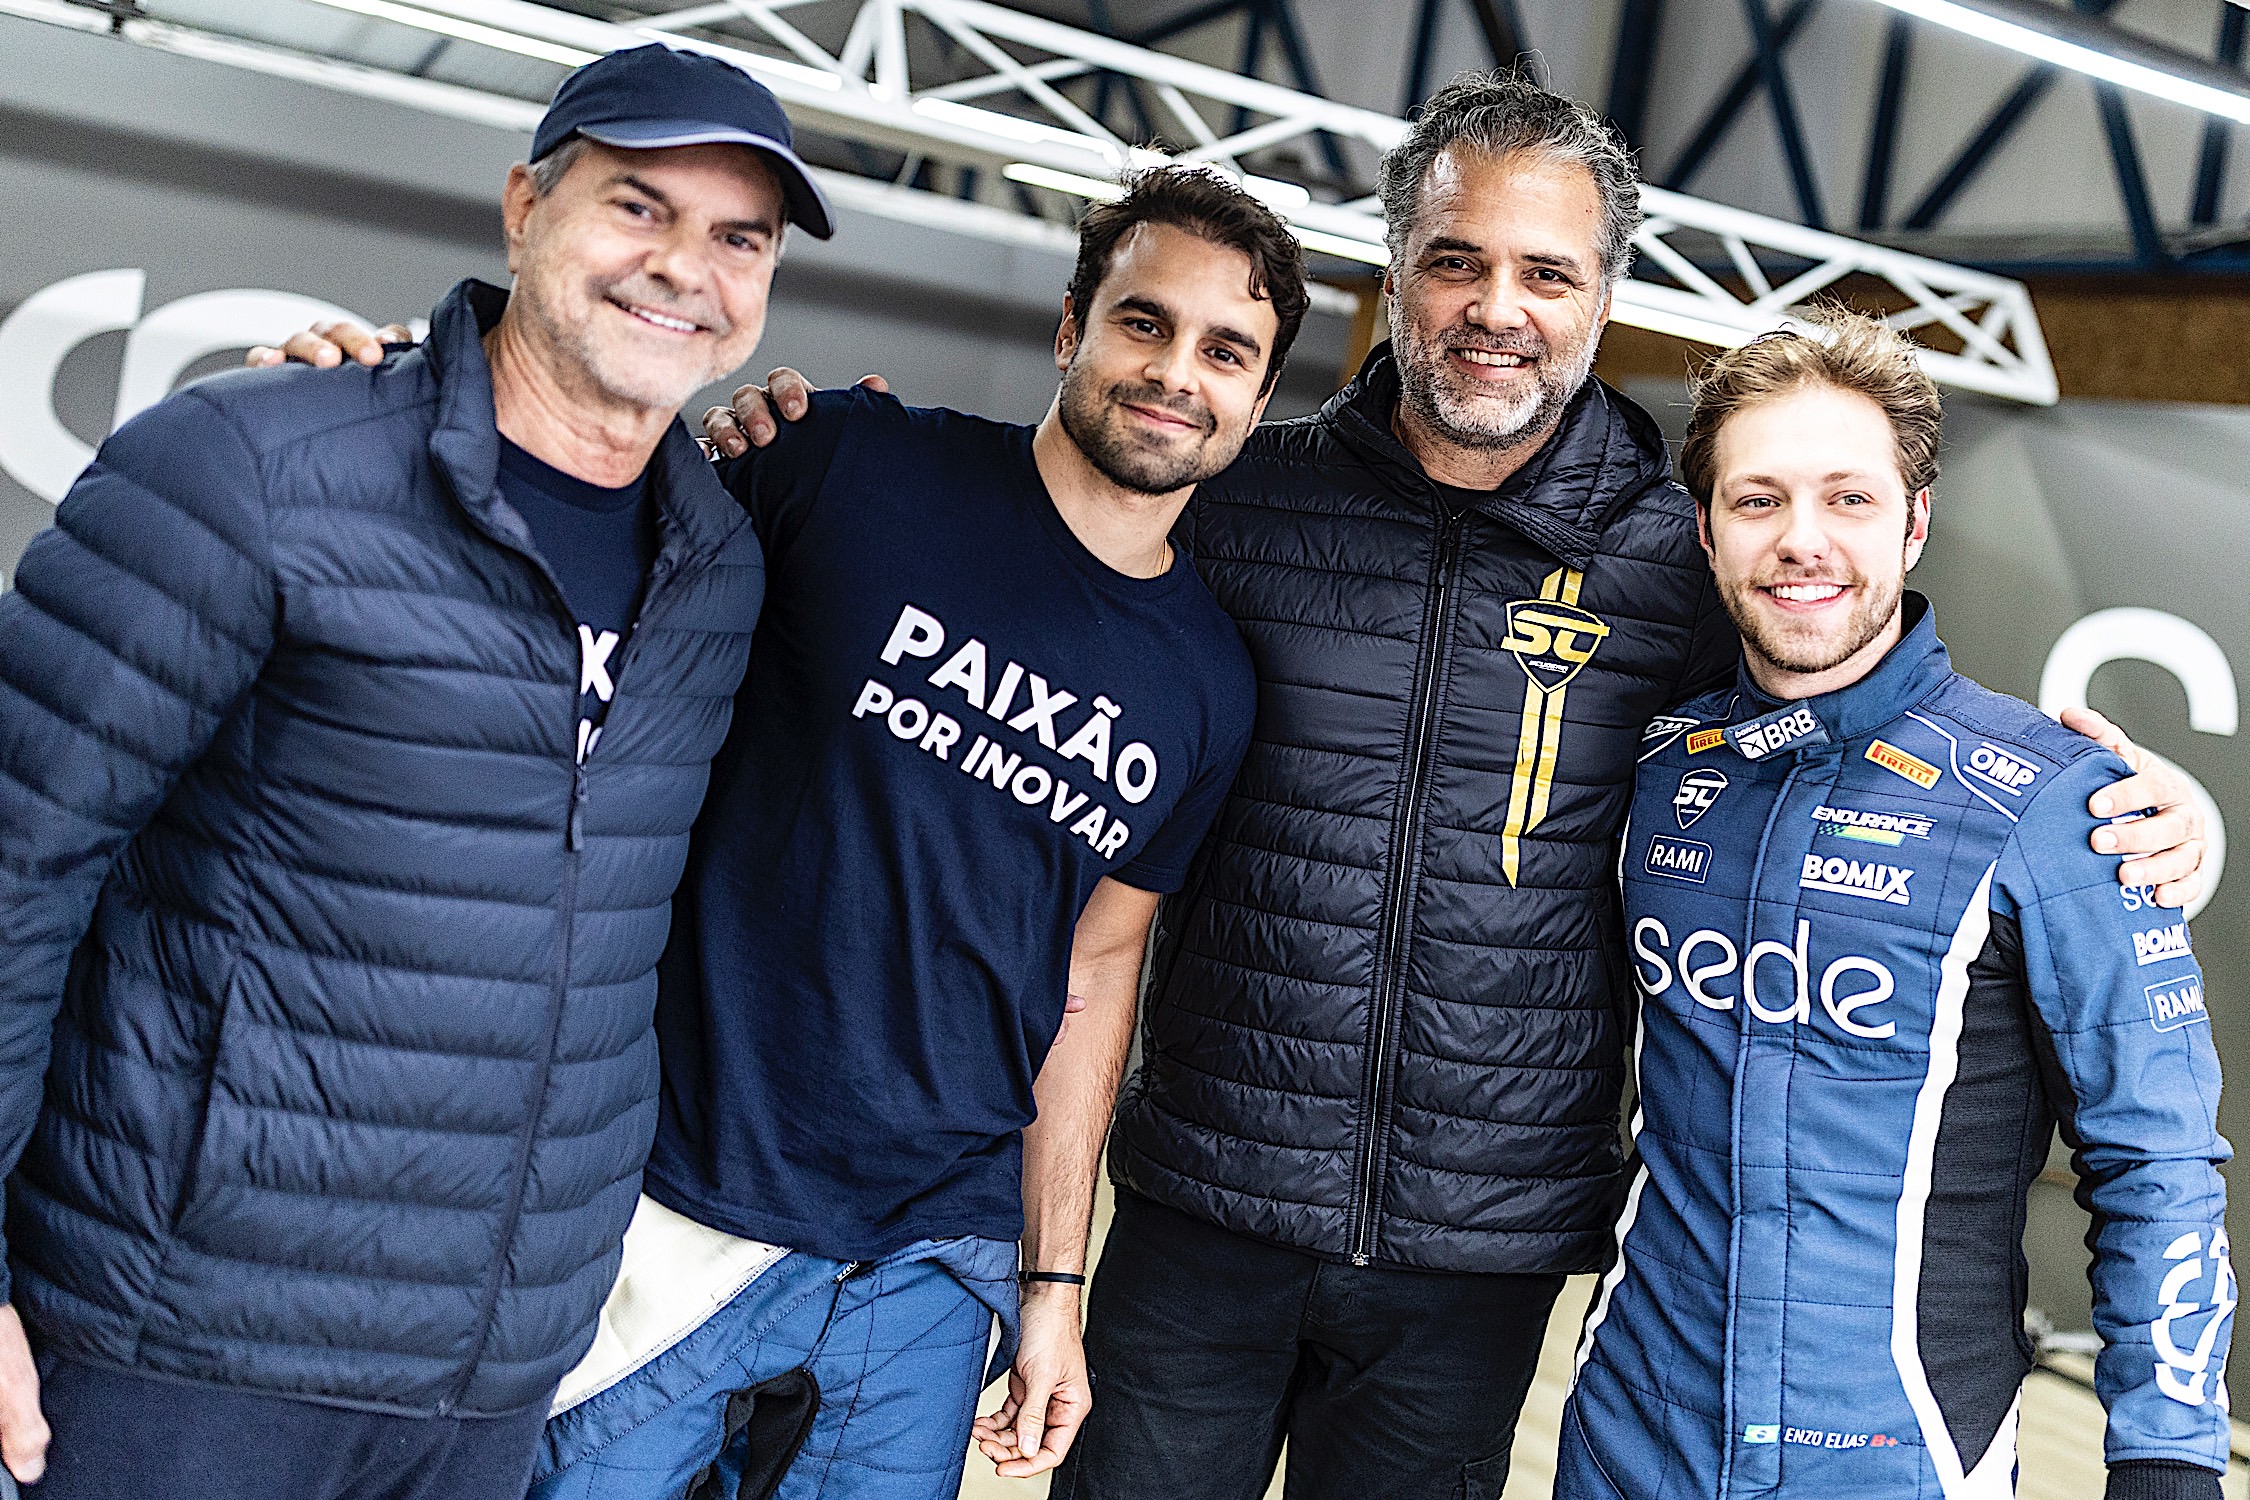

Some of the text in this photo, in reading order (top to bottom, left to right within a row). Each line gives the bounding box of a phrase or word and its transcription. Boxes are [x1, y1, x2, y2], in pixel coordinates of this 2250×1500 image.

[880, 604, 1157, 803] PAIXÃO
[1763, 708, 1816, 750] BRB
[852, 679, 1130, 860] POR INOVAR
[1872, 744, 1935, 784] PIRELLI
[1969, 747, 2036, 788] OMP
[1811, 805, 1933, 836] ENDURANCE
[1650, 844, 1704, 873] RAMI
[1801, 853, 1915, 902] BOMIX
[1634, 917, 1896, 1039] sede
[1783, 1427, 1899, 1449] ENZO ELIAS B+
